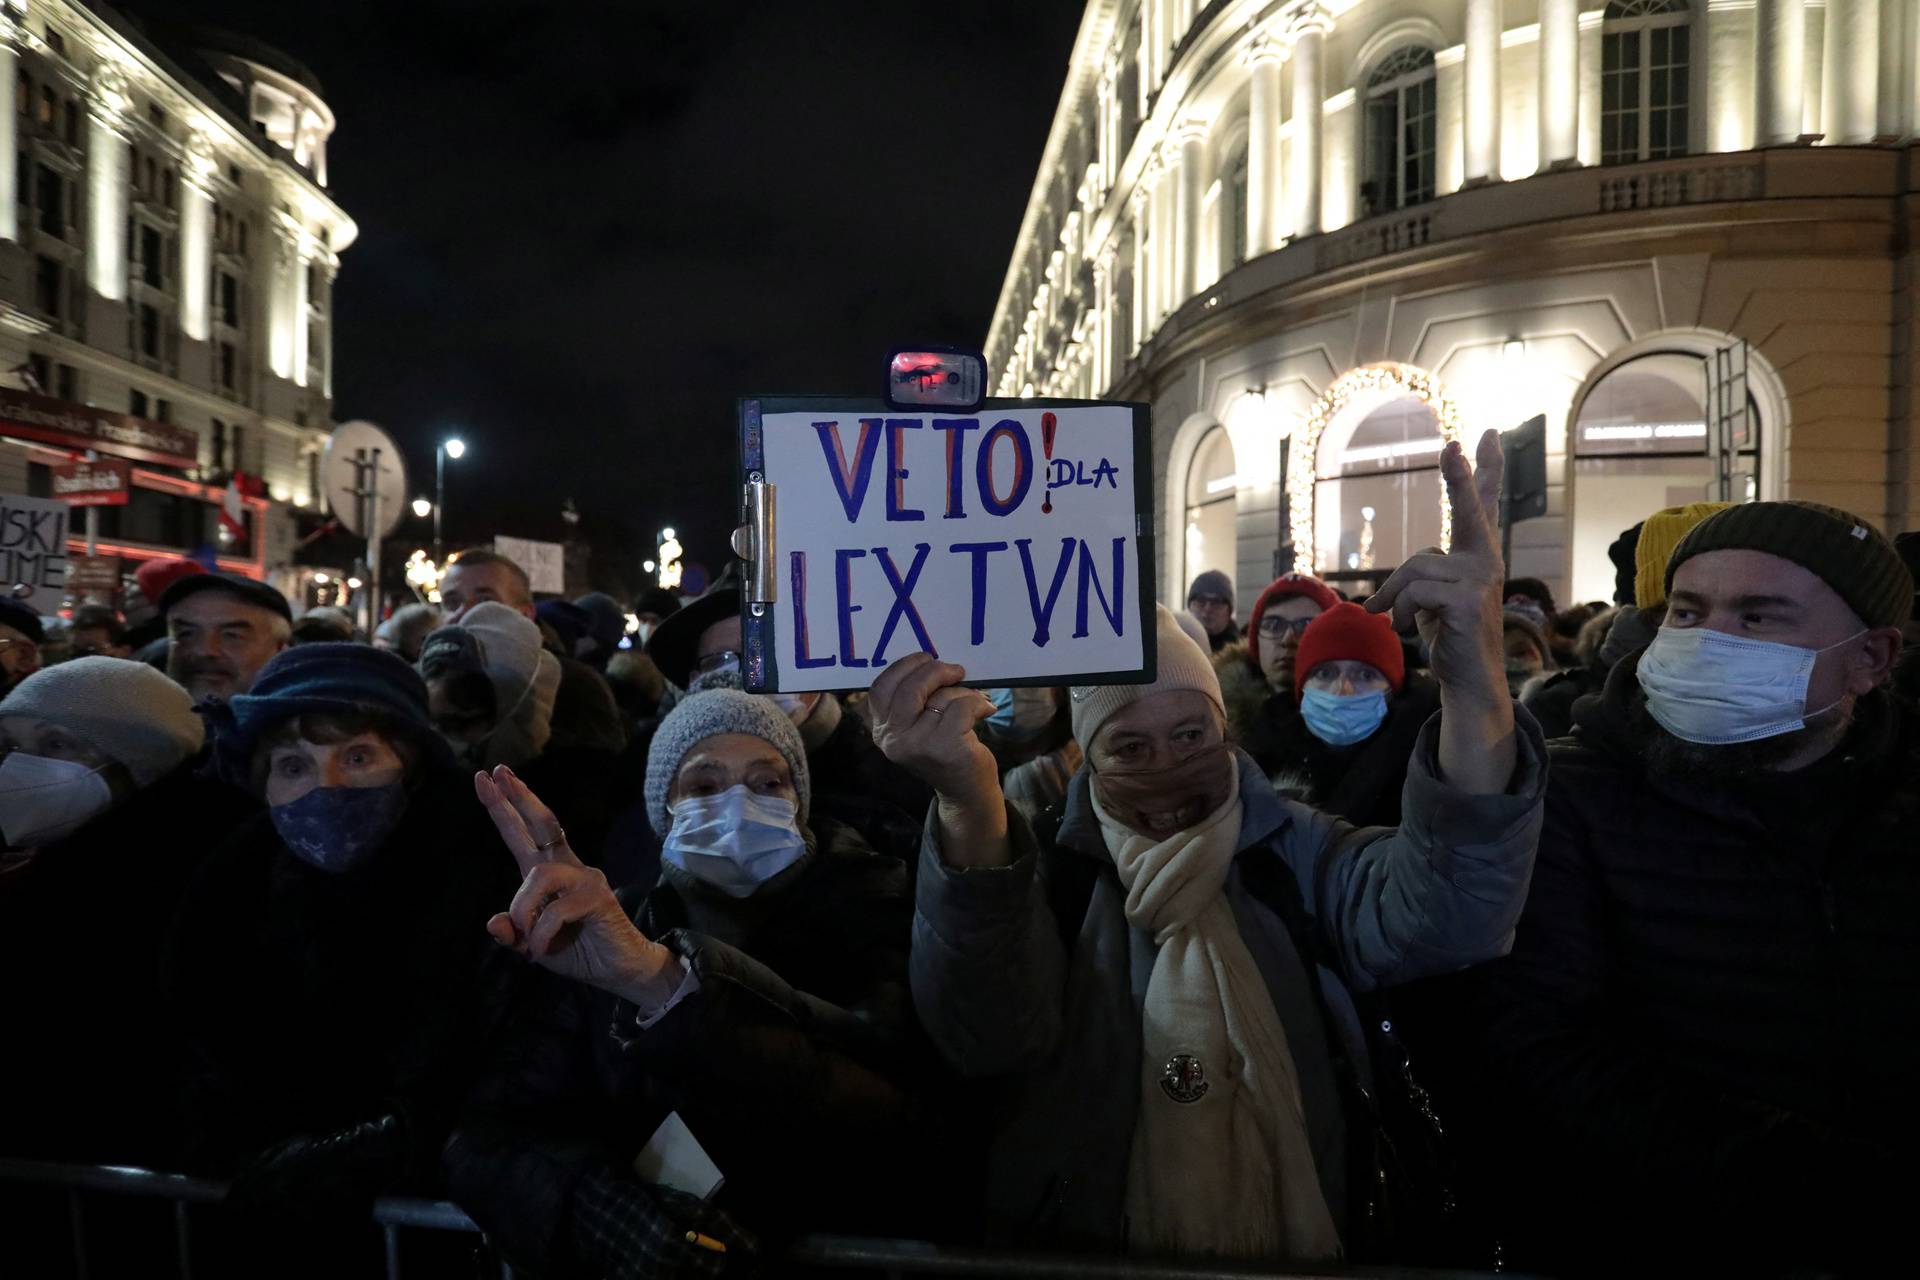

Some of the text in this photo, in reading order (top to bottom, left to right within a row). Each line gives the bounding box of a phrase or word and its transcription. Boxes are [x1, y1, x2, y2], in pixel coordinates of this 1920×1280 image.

[811, 411, 1119, 523] VETO! DLA
[790, 536, 1126, 669] LEX TVN
